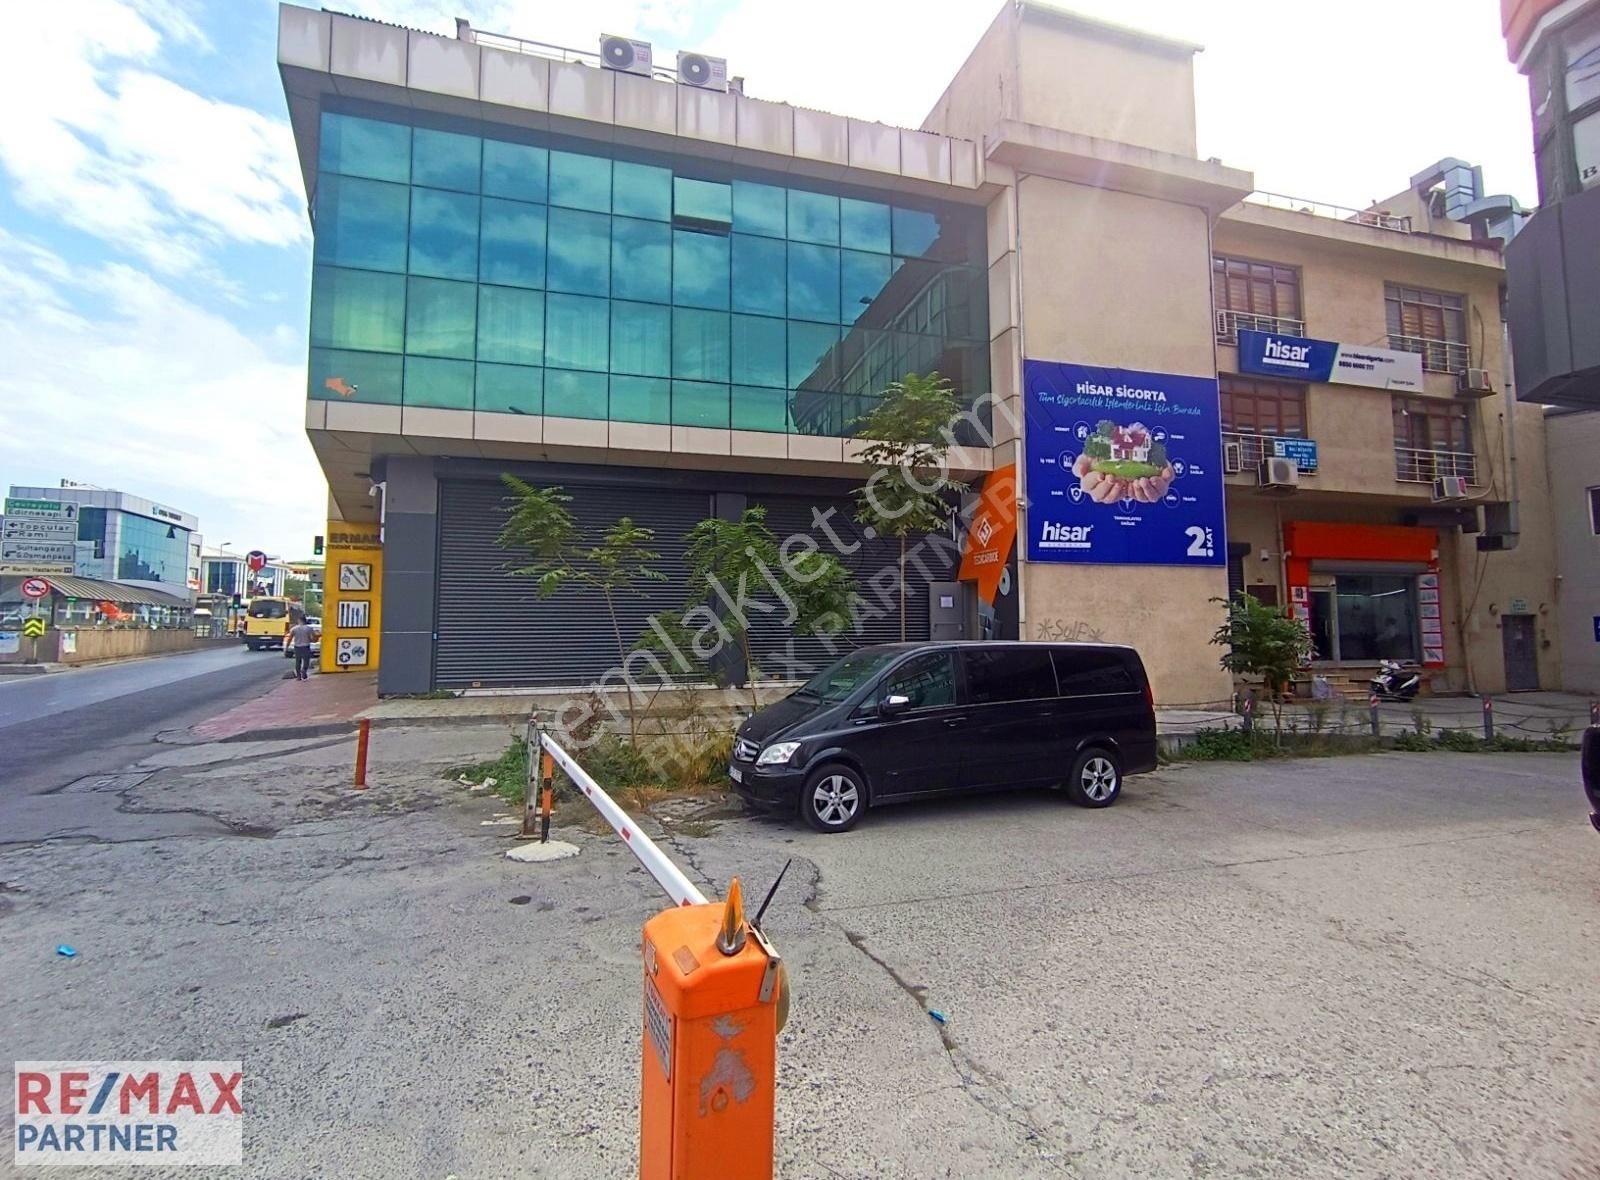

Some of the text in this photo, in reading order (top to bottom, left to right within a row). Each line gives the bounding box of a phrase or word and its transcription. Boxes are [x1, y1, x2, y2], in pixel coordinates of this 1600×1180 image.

[1265, 337, 1309, 361] hisar
[1076, 381, 1167, 402] HİSAR SİGORTA
[1041, 520, 1092, 541] hisar
